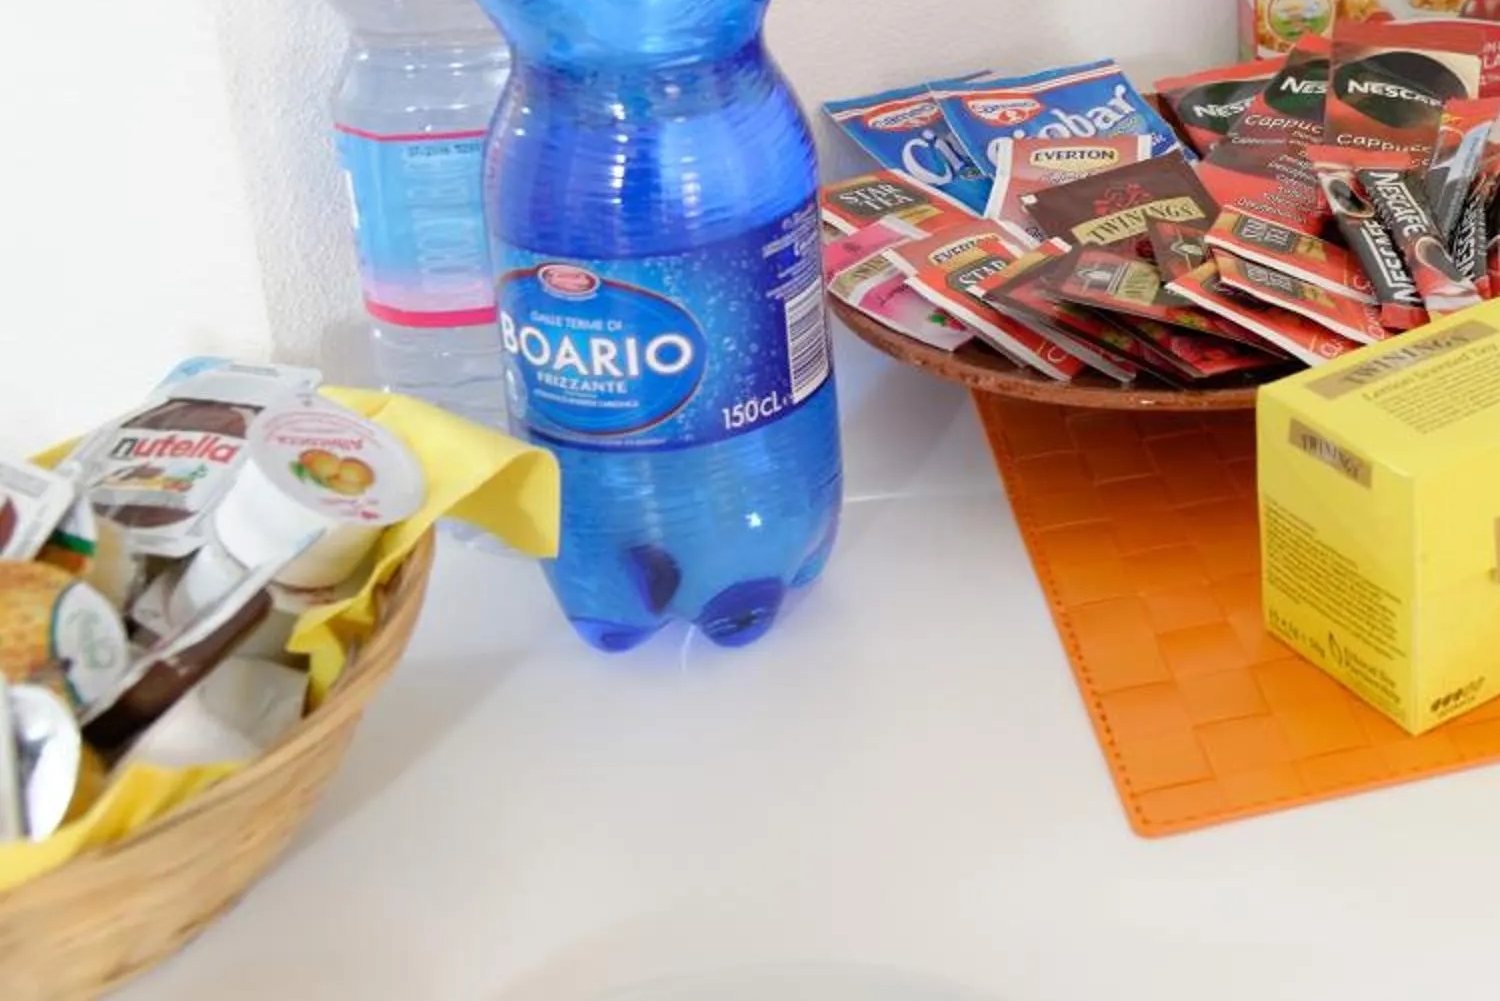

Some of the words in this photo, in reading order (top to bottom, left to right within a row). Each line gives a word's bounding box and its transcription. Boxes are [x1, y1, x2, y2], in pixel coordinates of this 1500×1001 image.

[1034, 147, 1115, 161] EVERTON
[501, 310, 693, 377] BOARIO
[1341, 336, 1470, 386] TWININGS
[537, 370, 628, 394] FRIZZANTE
[109, 434, 239, 464] nutella
